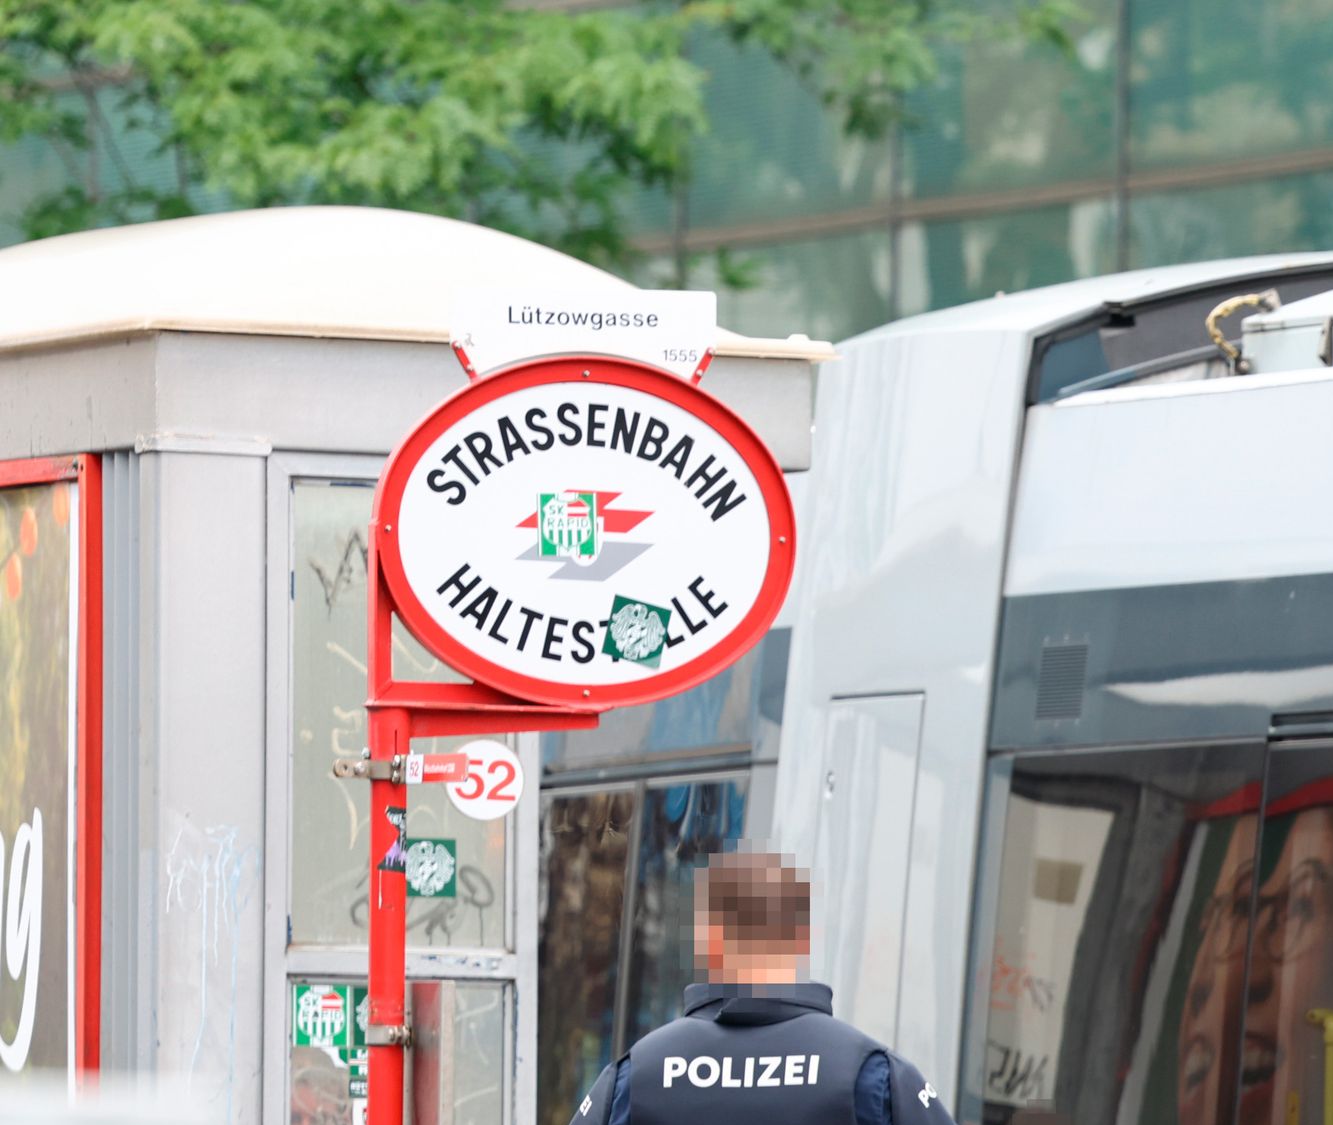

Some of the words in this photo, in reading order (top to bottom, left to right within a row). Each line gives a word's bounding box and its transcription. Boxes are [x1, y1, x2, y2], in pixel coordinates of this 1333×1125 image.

[507, 305, 660, 331] Lützowgasse
[662, 348, 699, 363] 1555
[426, 402, 747, 522] STRASSENBAHN
[547, 517, 589, 528] RAPID
[437, 563, 729, 664] HALTESLLE
[408, 760, 420, 777] 52
[454, 759, 517, 802] 52
[662, 1053, 820, 1089] POLIZEI
